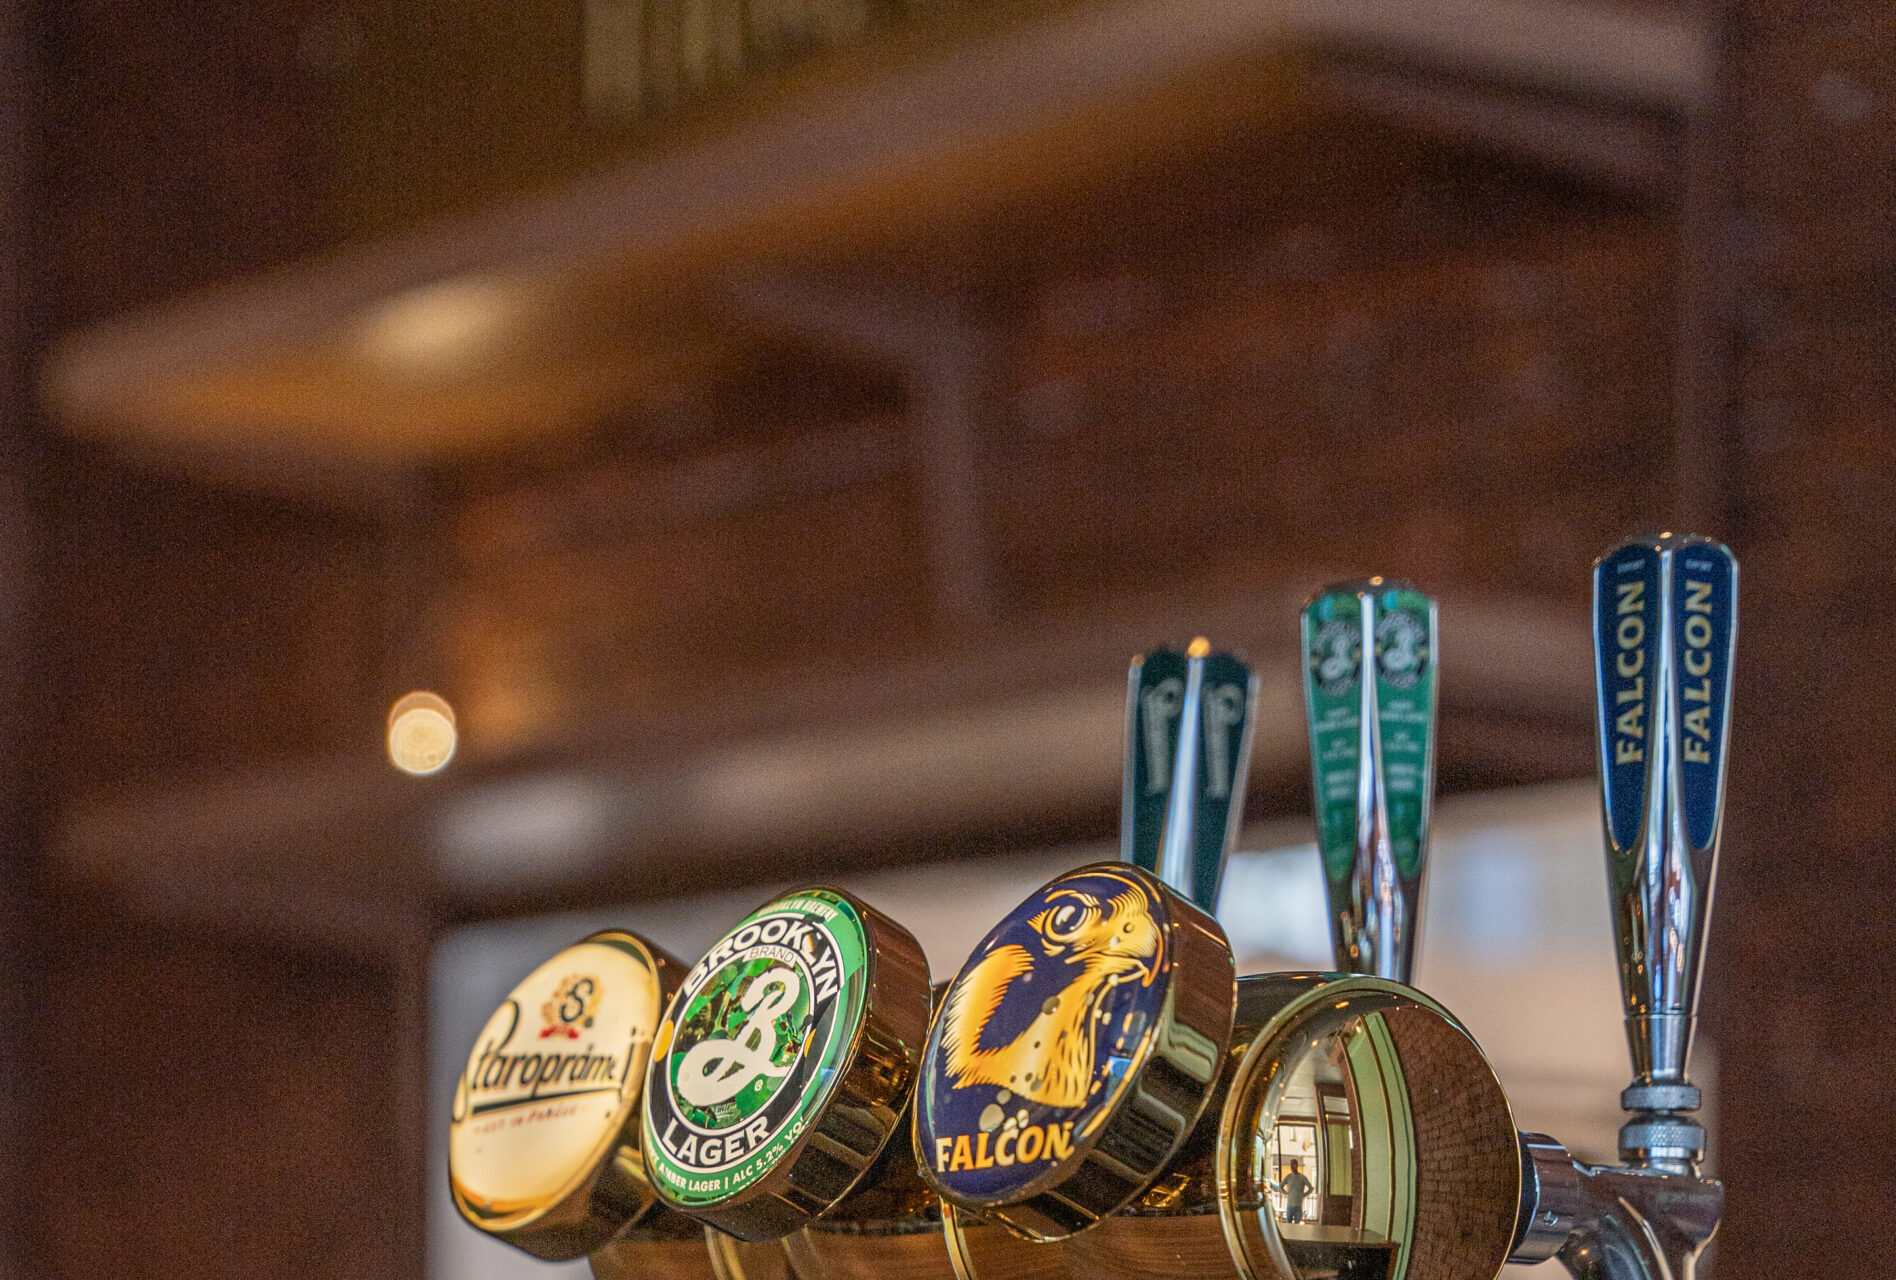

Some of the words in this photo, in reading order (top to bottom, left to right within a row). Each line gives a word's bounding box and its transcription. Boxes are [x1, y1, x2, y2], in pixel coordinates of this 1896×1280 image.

[1615, 580, 1646, 765] FALCON
[1684, 579, 1713, 764] FALCON
[749, 945, 795, 963] BRAND
[661, 1115, 771, 1166] LAGER
[935, 1120, 1076, 1173] FALCON
[658, 1163, 687, 1190] AMBER
[688, 1179, 721, 1192] LAGER
[732, 1167, 754, 1184] ALC
[755, 1142, 784, 1171] 5.2%
